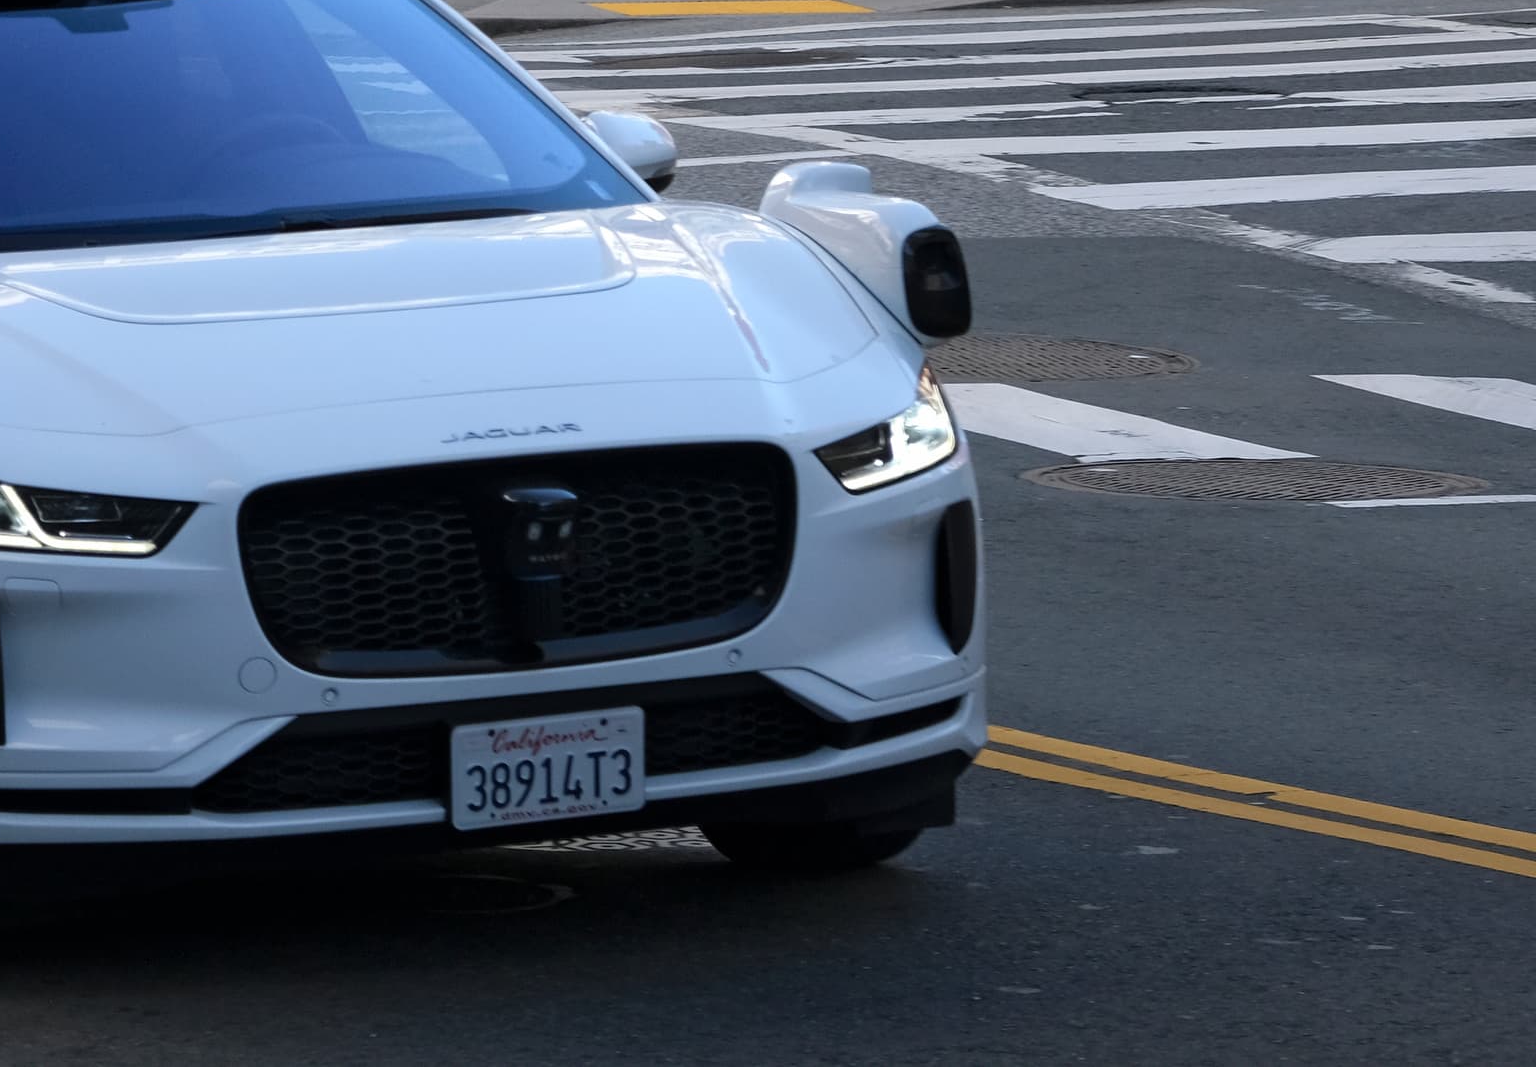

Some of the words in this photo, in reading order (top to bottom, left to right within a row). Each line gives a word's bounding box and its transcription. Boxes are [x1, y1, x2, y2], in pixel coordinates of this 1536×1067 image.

[440, 422, 583, 444] JAGUAR
[492, 726, 608, 757] California
[467, 749, 632, 813] 38914T3
[500, 804, 598, 821] dmv.ca.gov
